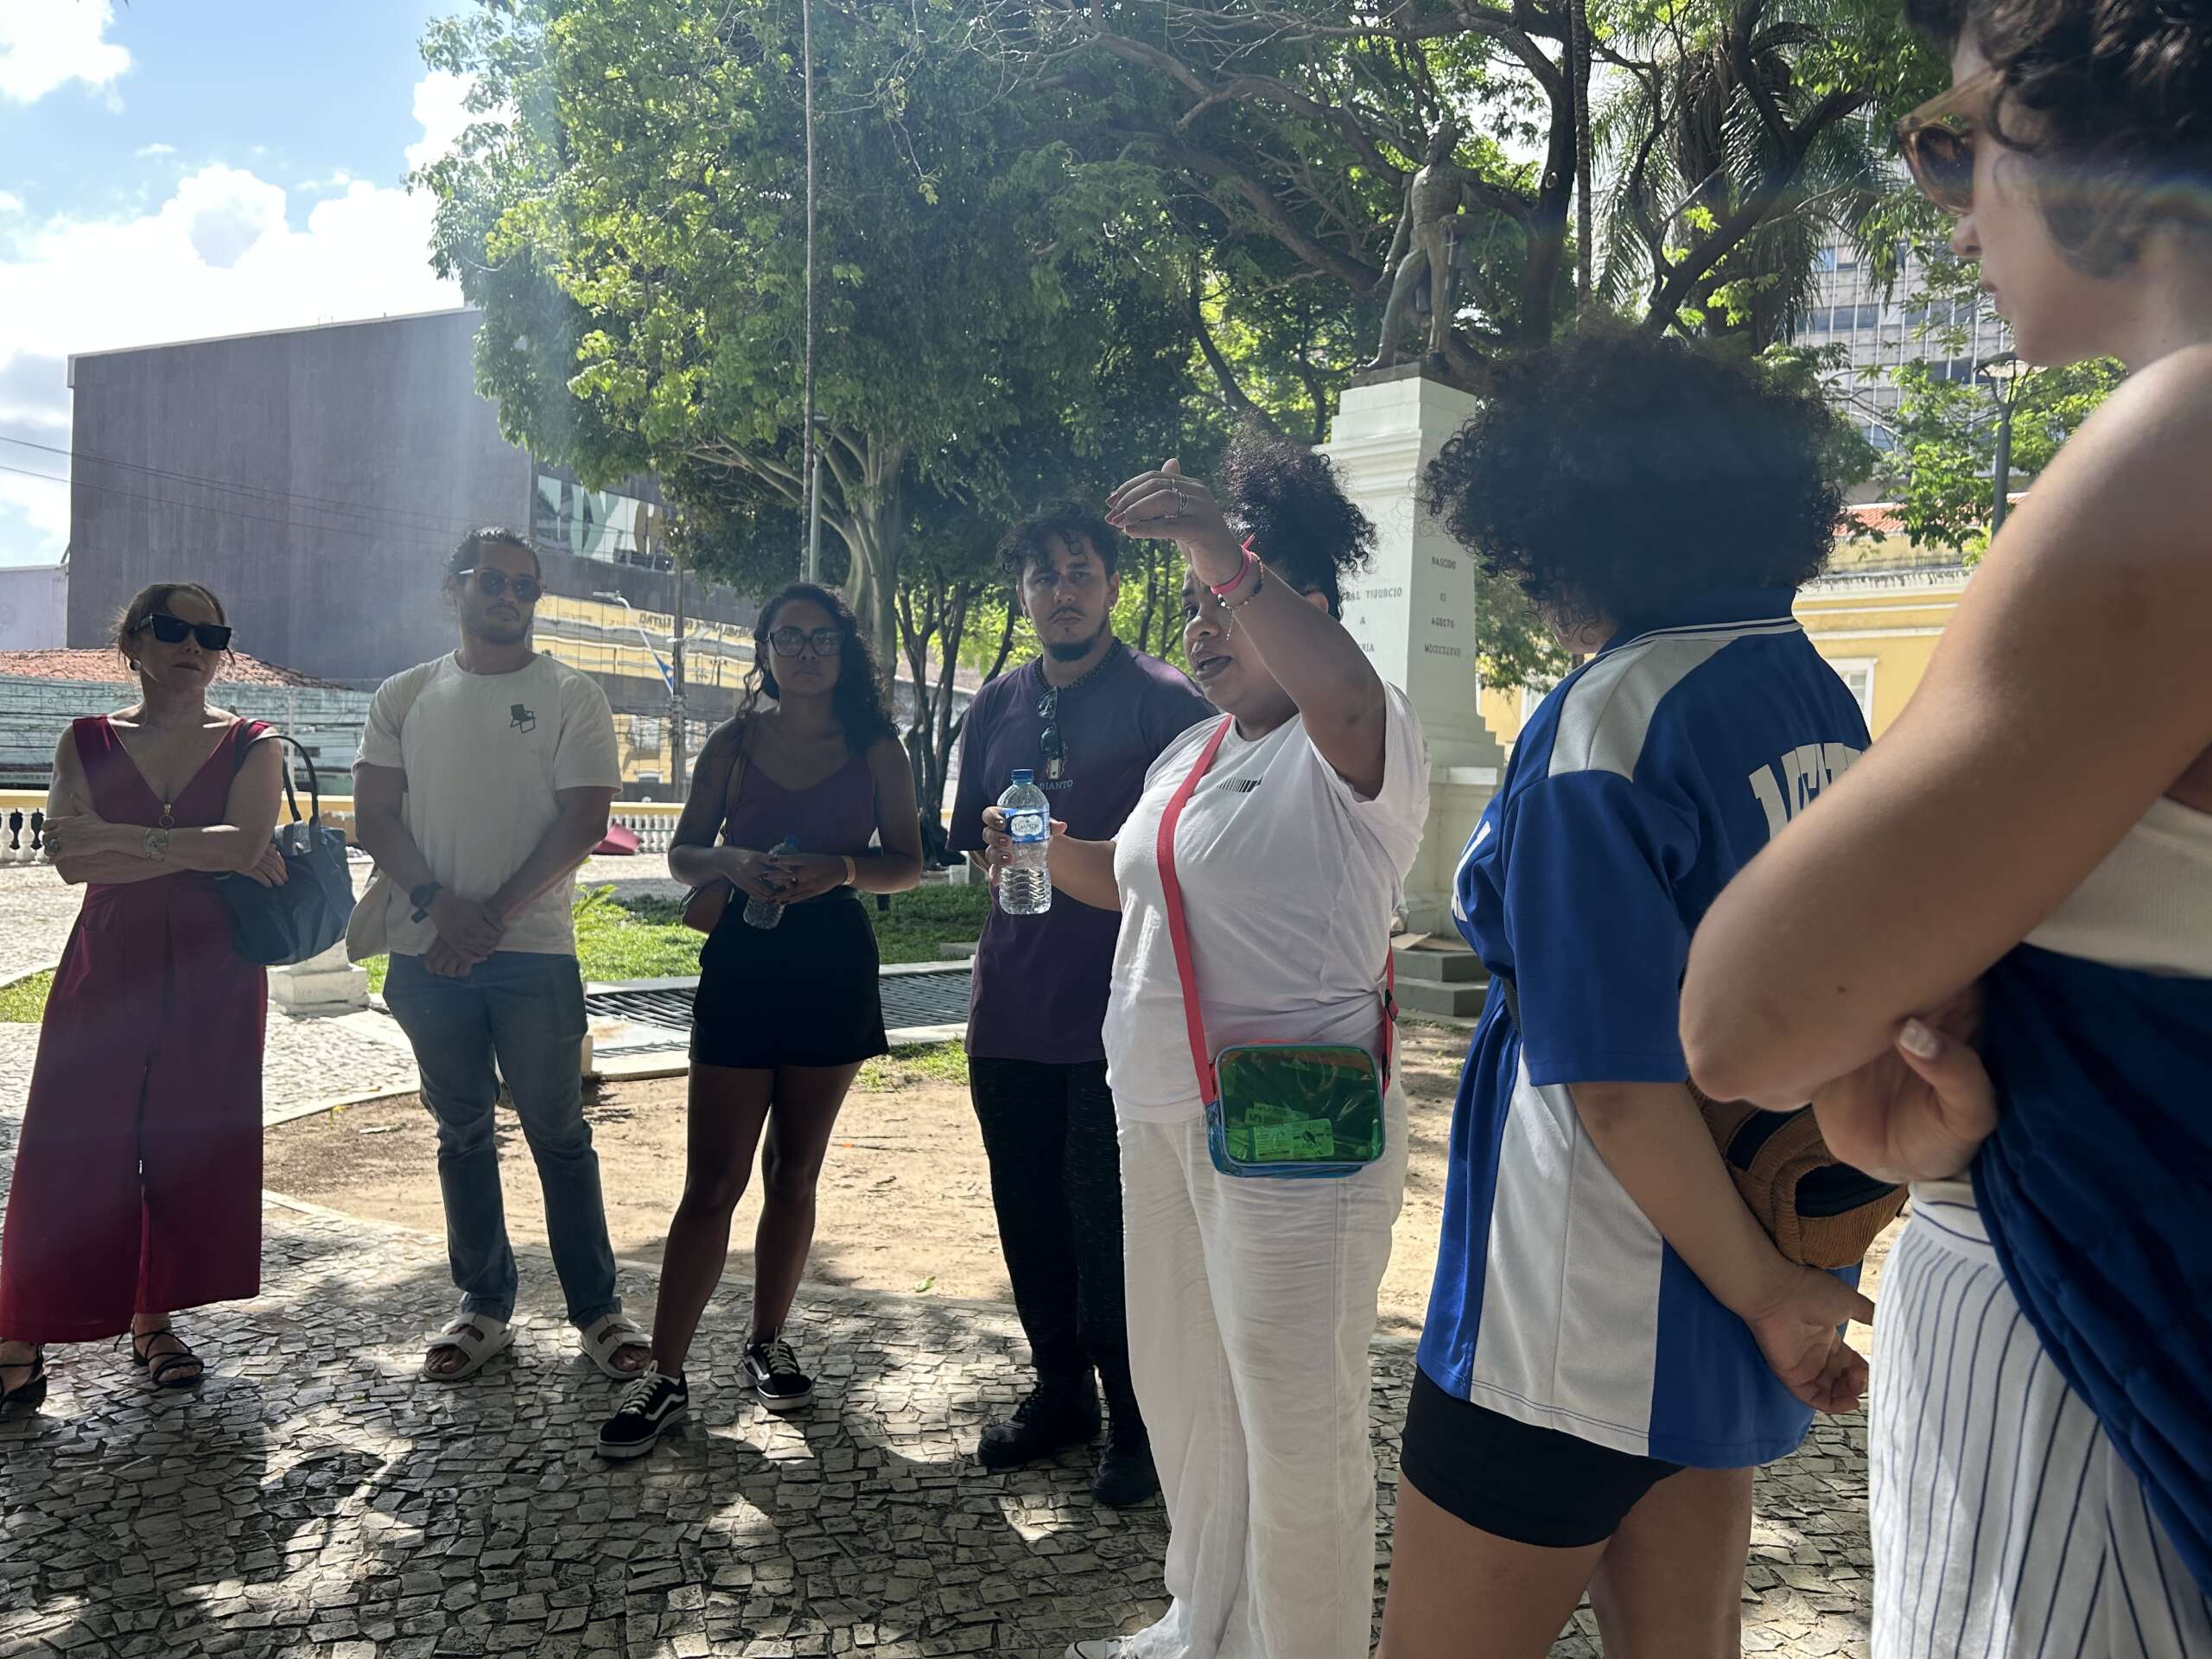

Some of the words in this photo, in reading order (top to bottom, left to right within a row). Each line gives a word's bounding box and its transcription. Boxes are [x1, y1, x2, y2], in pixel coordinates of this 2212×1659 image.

[1360, 616, 1366, 626] A
[1359, 643, 1375, 652] RIA
[1038, 779, 1073, 790] DIANTO
